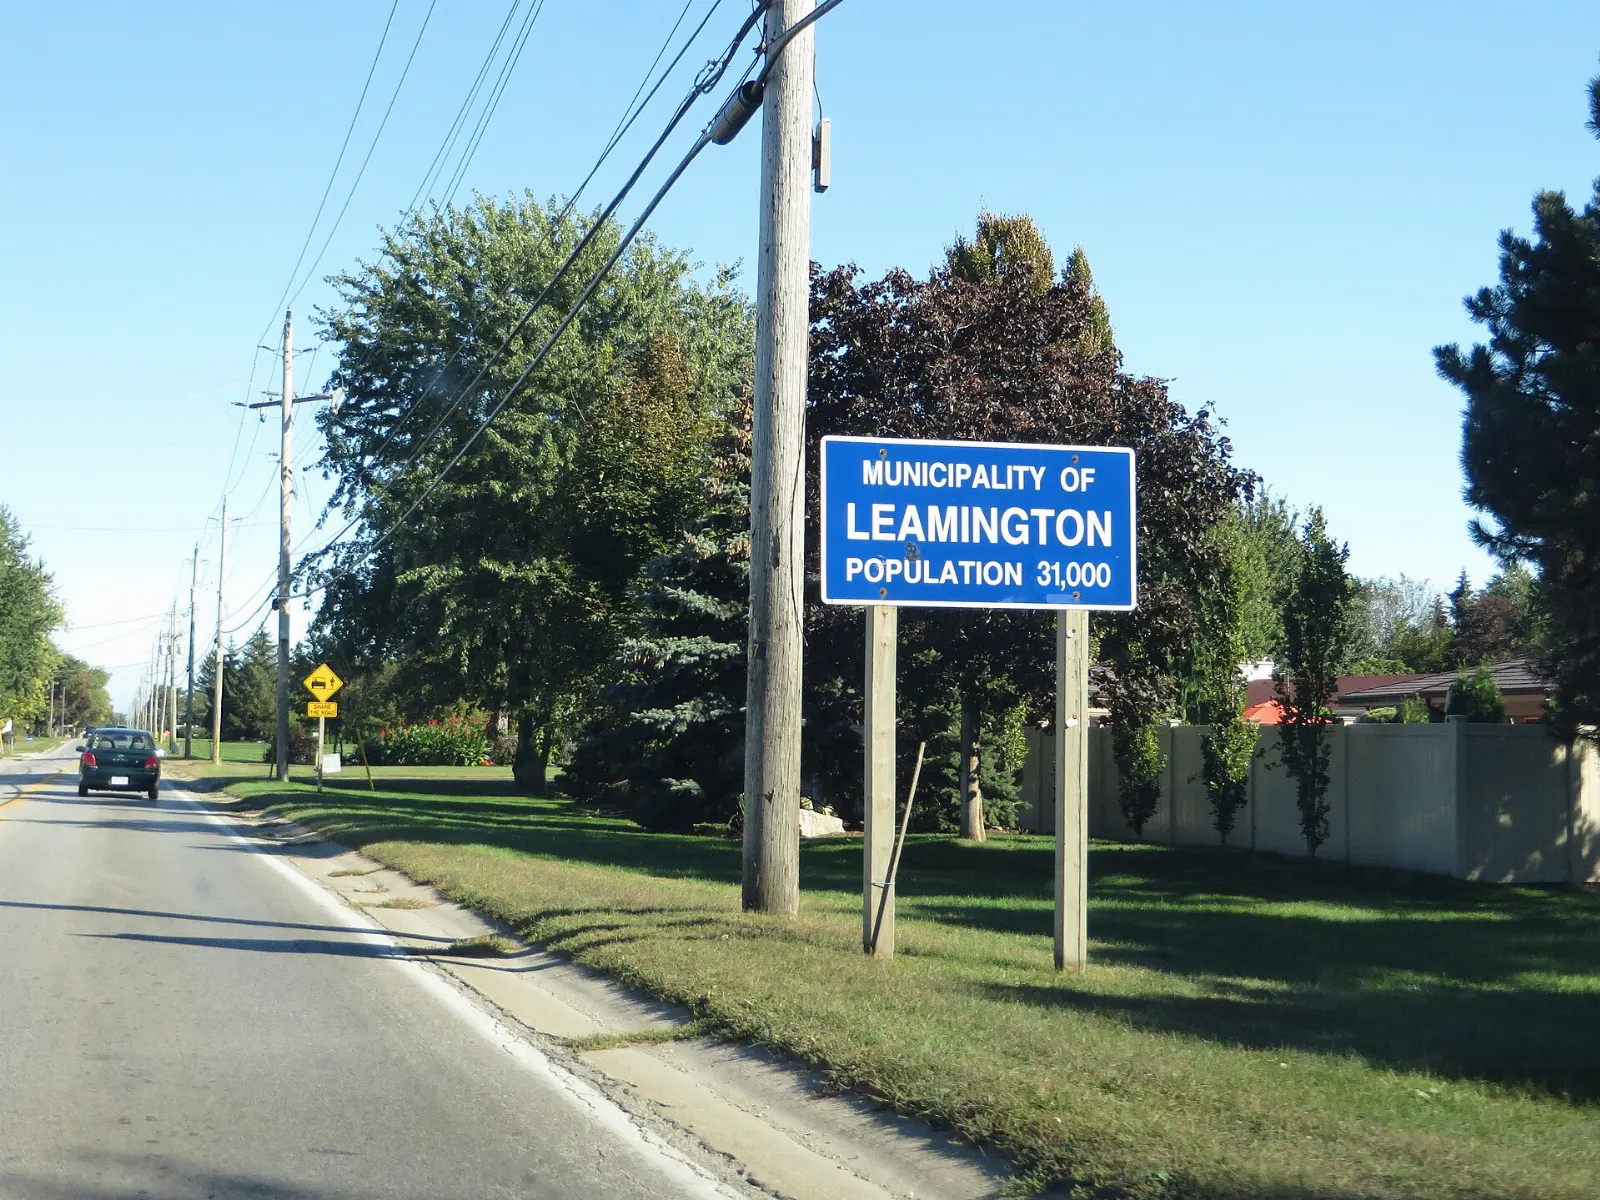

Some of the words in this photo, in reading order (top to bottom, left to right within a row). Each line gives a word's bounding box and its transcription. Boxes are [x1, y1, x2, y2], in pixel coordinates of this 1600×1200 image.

[862, 459, 1047, 491] MUNICIPALITY
[1060, 466, 1096, 493] OF
[846, 502, 1112, 547] LEAMINGTON
[846, 557, 1023, 586] POPULATION
[1036, 560, 1112, 592] 31,000
